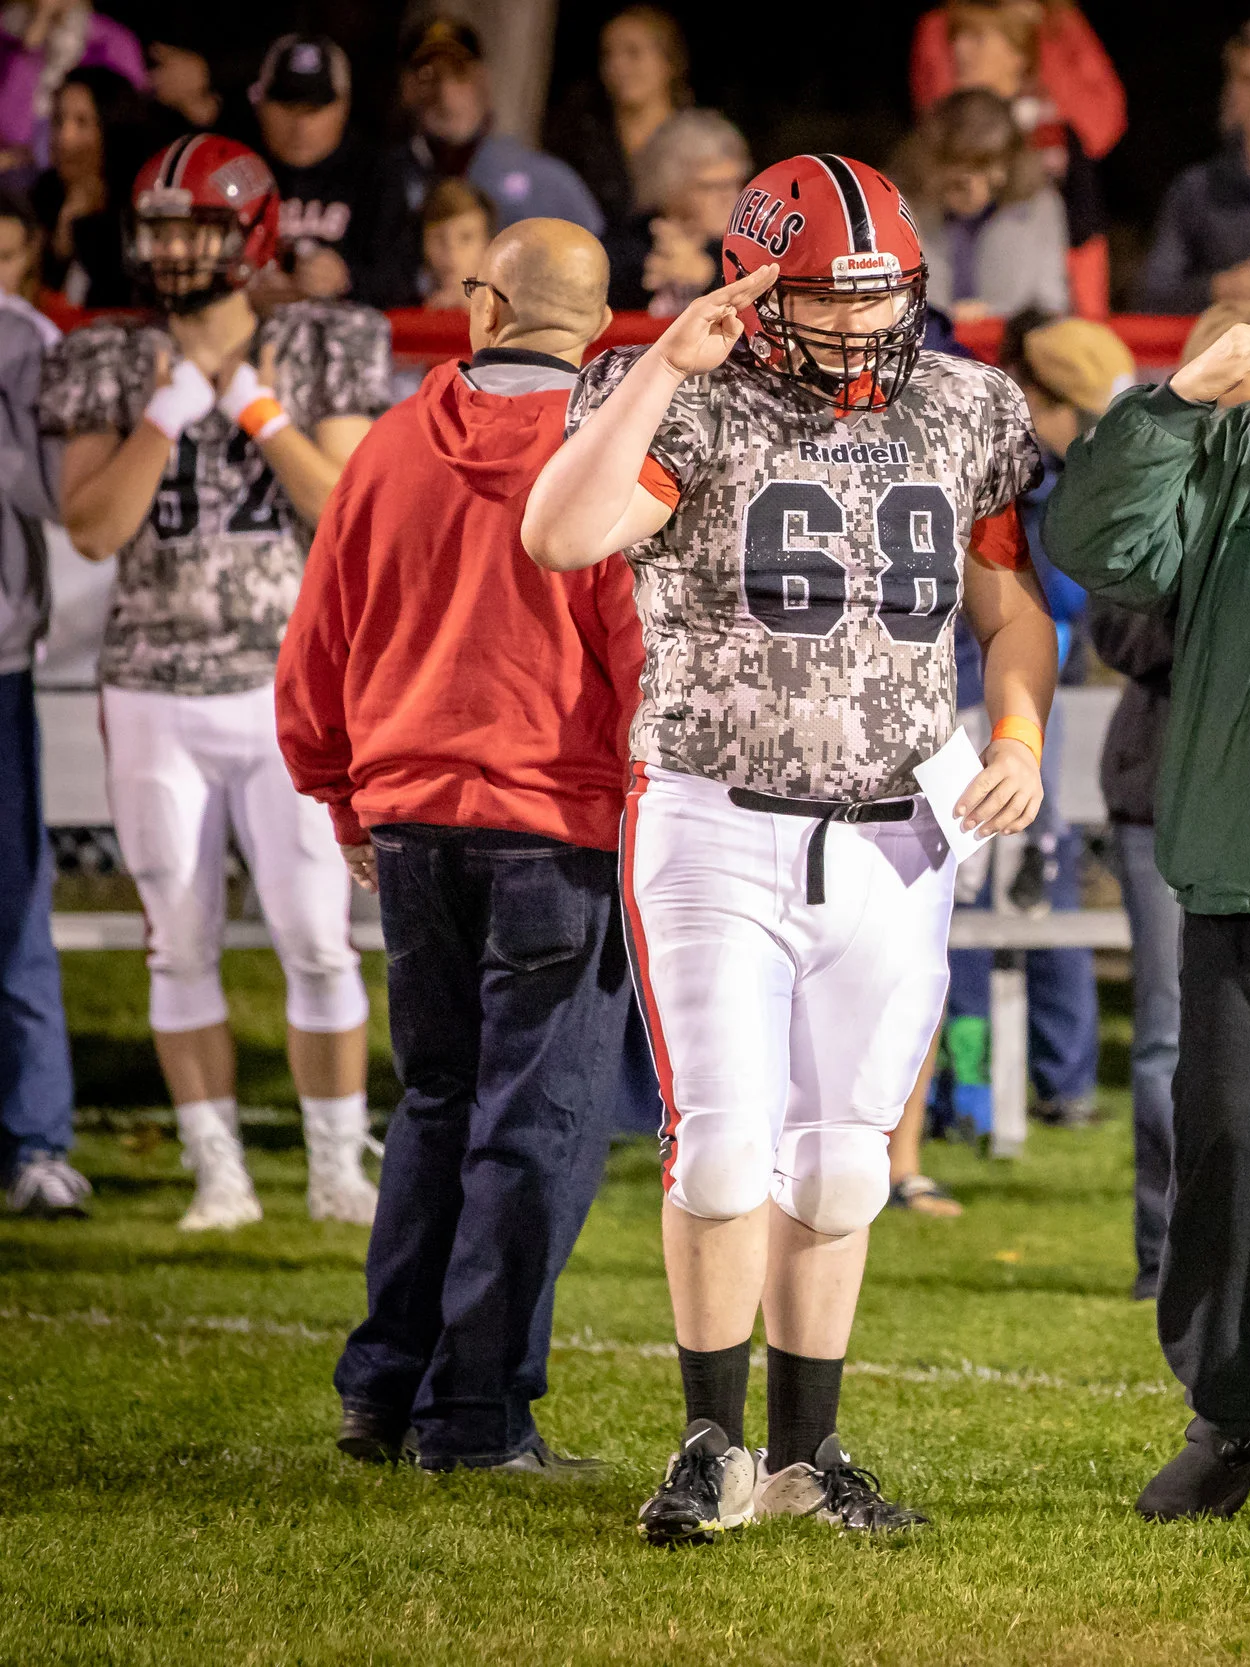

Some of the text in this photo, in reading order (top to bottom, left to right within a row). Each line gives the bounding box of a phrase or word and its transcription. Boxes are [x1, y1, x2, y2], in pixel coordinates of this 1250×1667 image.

[847, 256, 885, 270] Riddell
[797, 440, 910, 465] Riddell
[741, 478, 963, 647] 68
